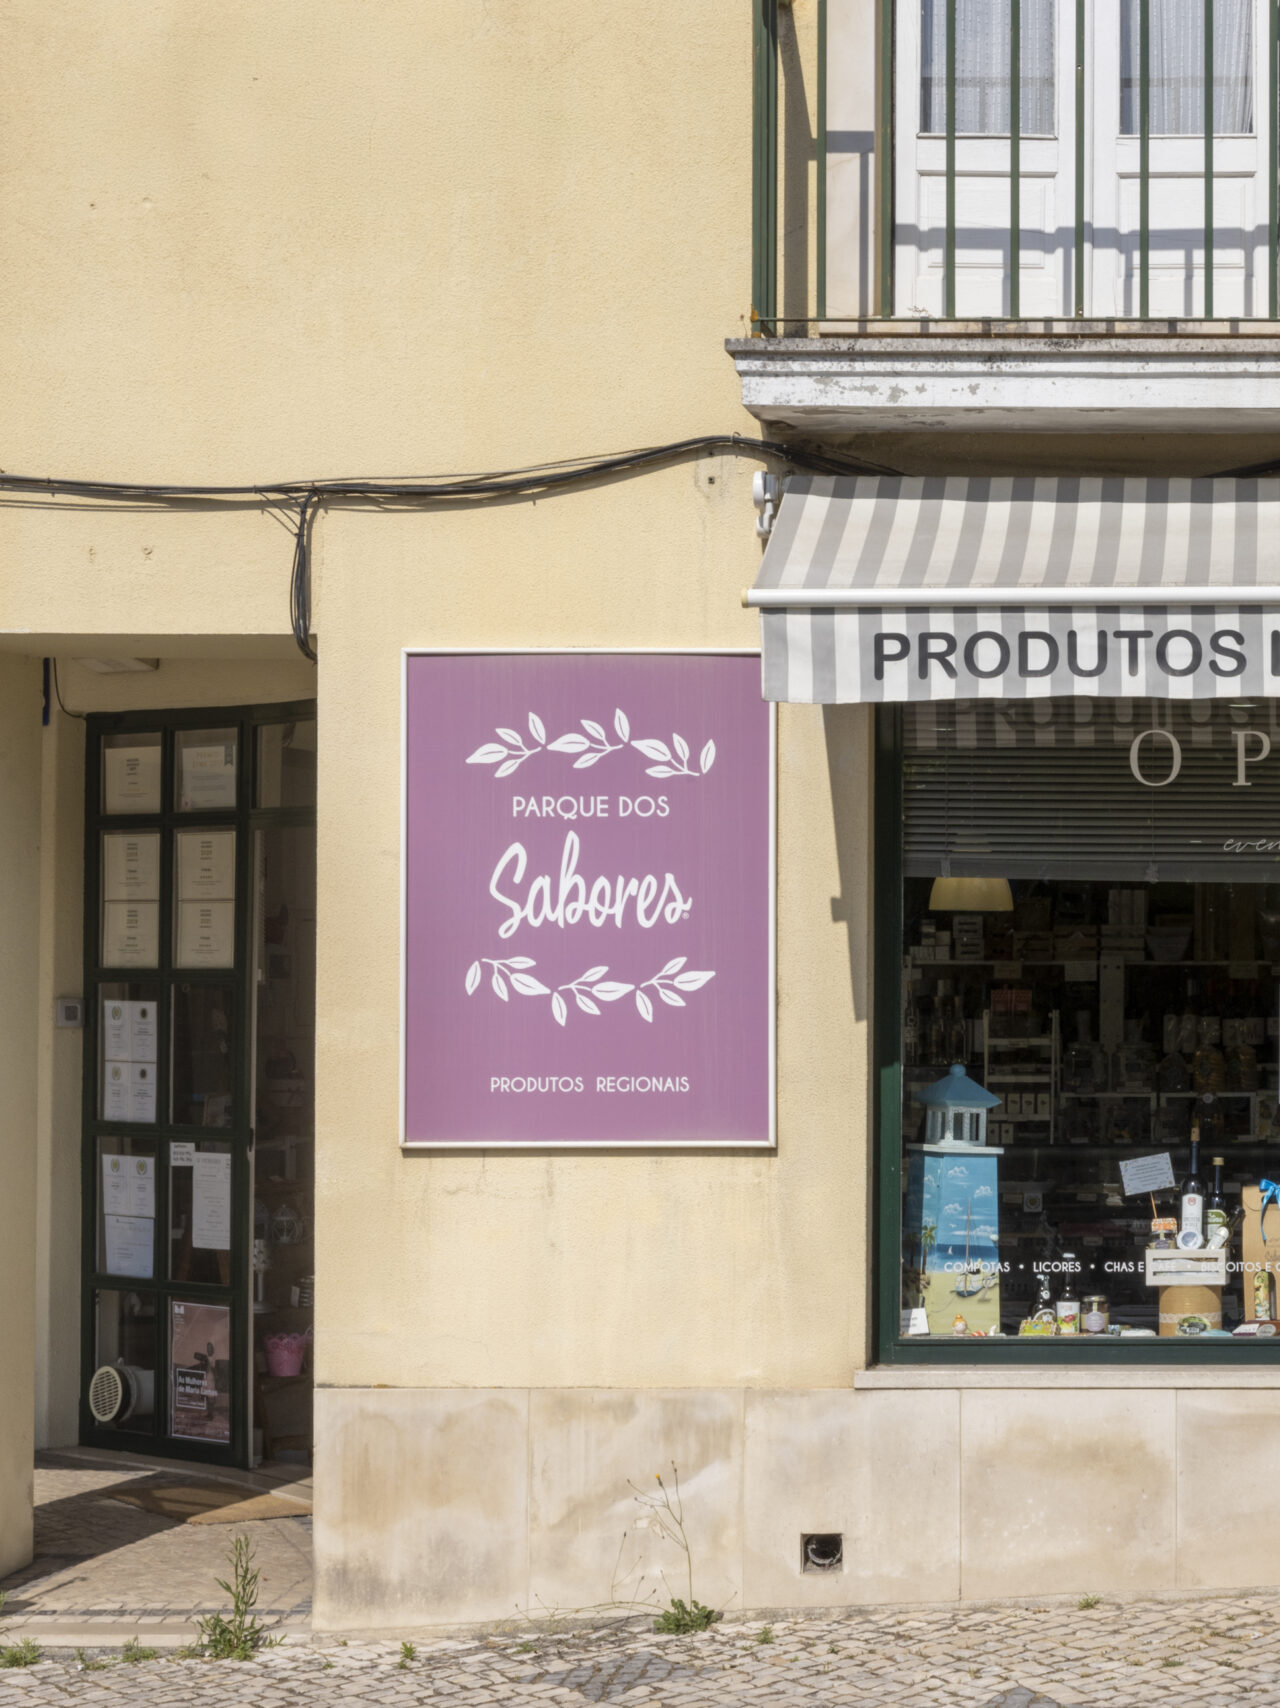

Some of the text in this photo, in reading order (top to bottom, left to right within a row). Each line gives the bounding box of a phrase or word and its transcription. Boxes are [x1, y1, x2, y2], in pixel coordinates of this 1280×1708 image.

[873, 629, 1249, 681] PRODUTOS
[1128, 729, 1183, 787] O
[512, 796, 670, 820] PARQUE DOS
[490, 1077, 690, 1093] PRODUTOS REGIONAIS
[944, 1261, 1011, 1273] COMPOTAS
[1033, 1261, 1081, 1273] LICORES
[1104, 1261, 1135, 1273] CHAS
[1137, 1261, 1145, 1273] E
[1201, 1261, 1263, 1273] BISCOITOS
[1265, 1261, 1273, 1273] E
